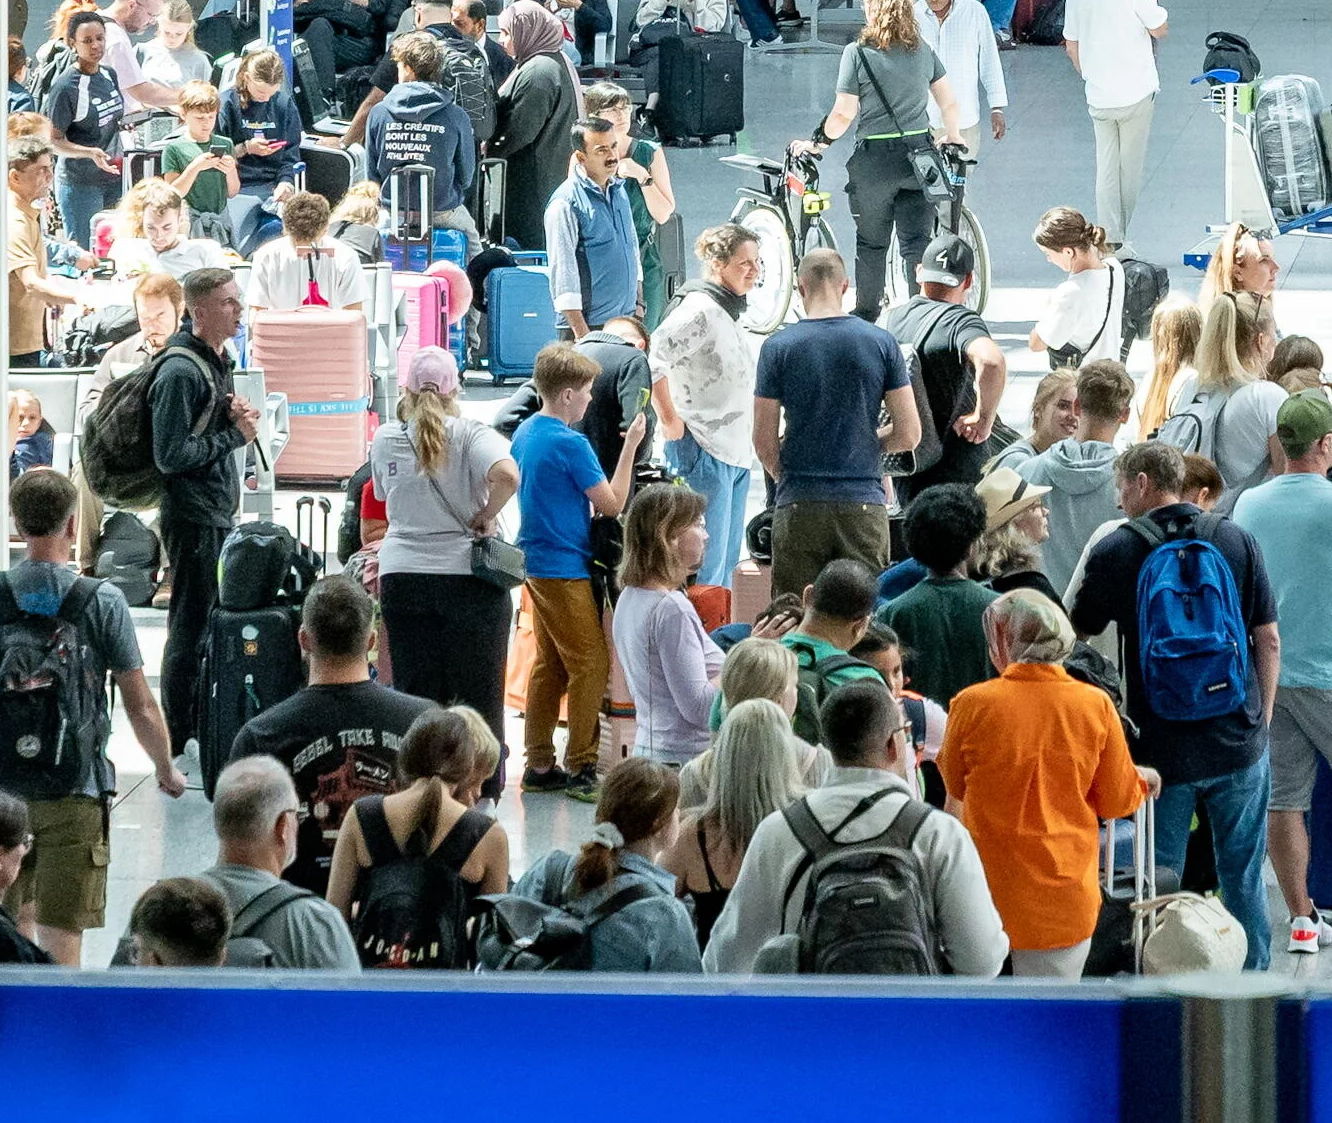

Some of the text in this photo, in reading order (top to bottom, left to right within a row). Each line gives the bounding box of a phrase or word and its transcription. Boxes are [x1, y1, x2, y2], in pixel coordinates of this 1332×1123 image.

[386, 122, 446, 134] LES CRÉATIFS
[385, 132, 427, 142] SONT LES
[385, 142, 431, 153] NOUVEAUX
[338, 728, 376, 748] TAKE
